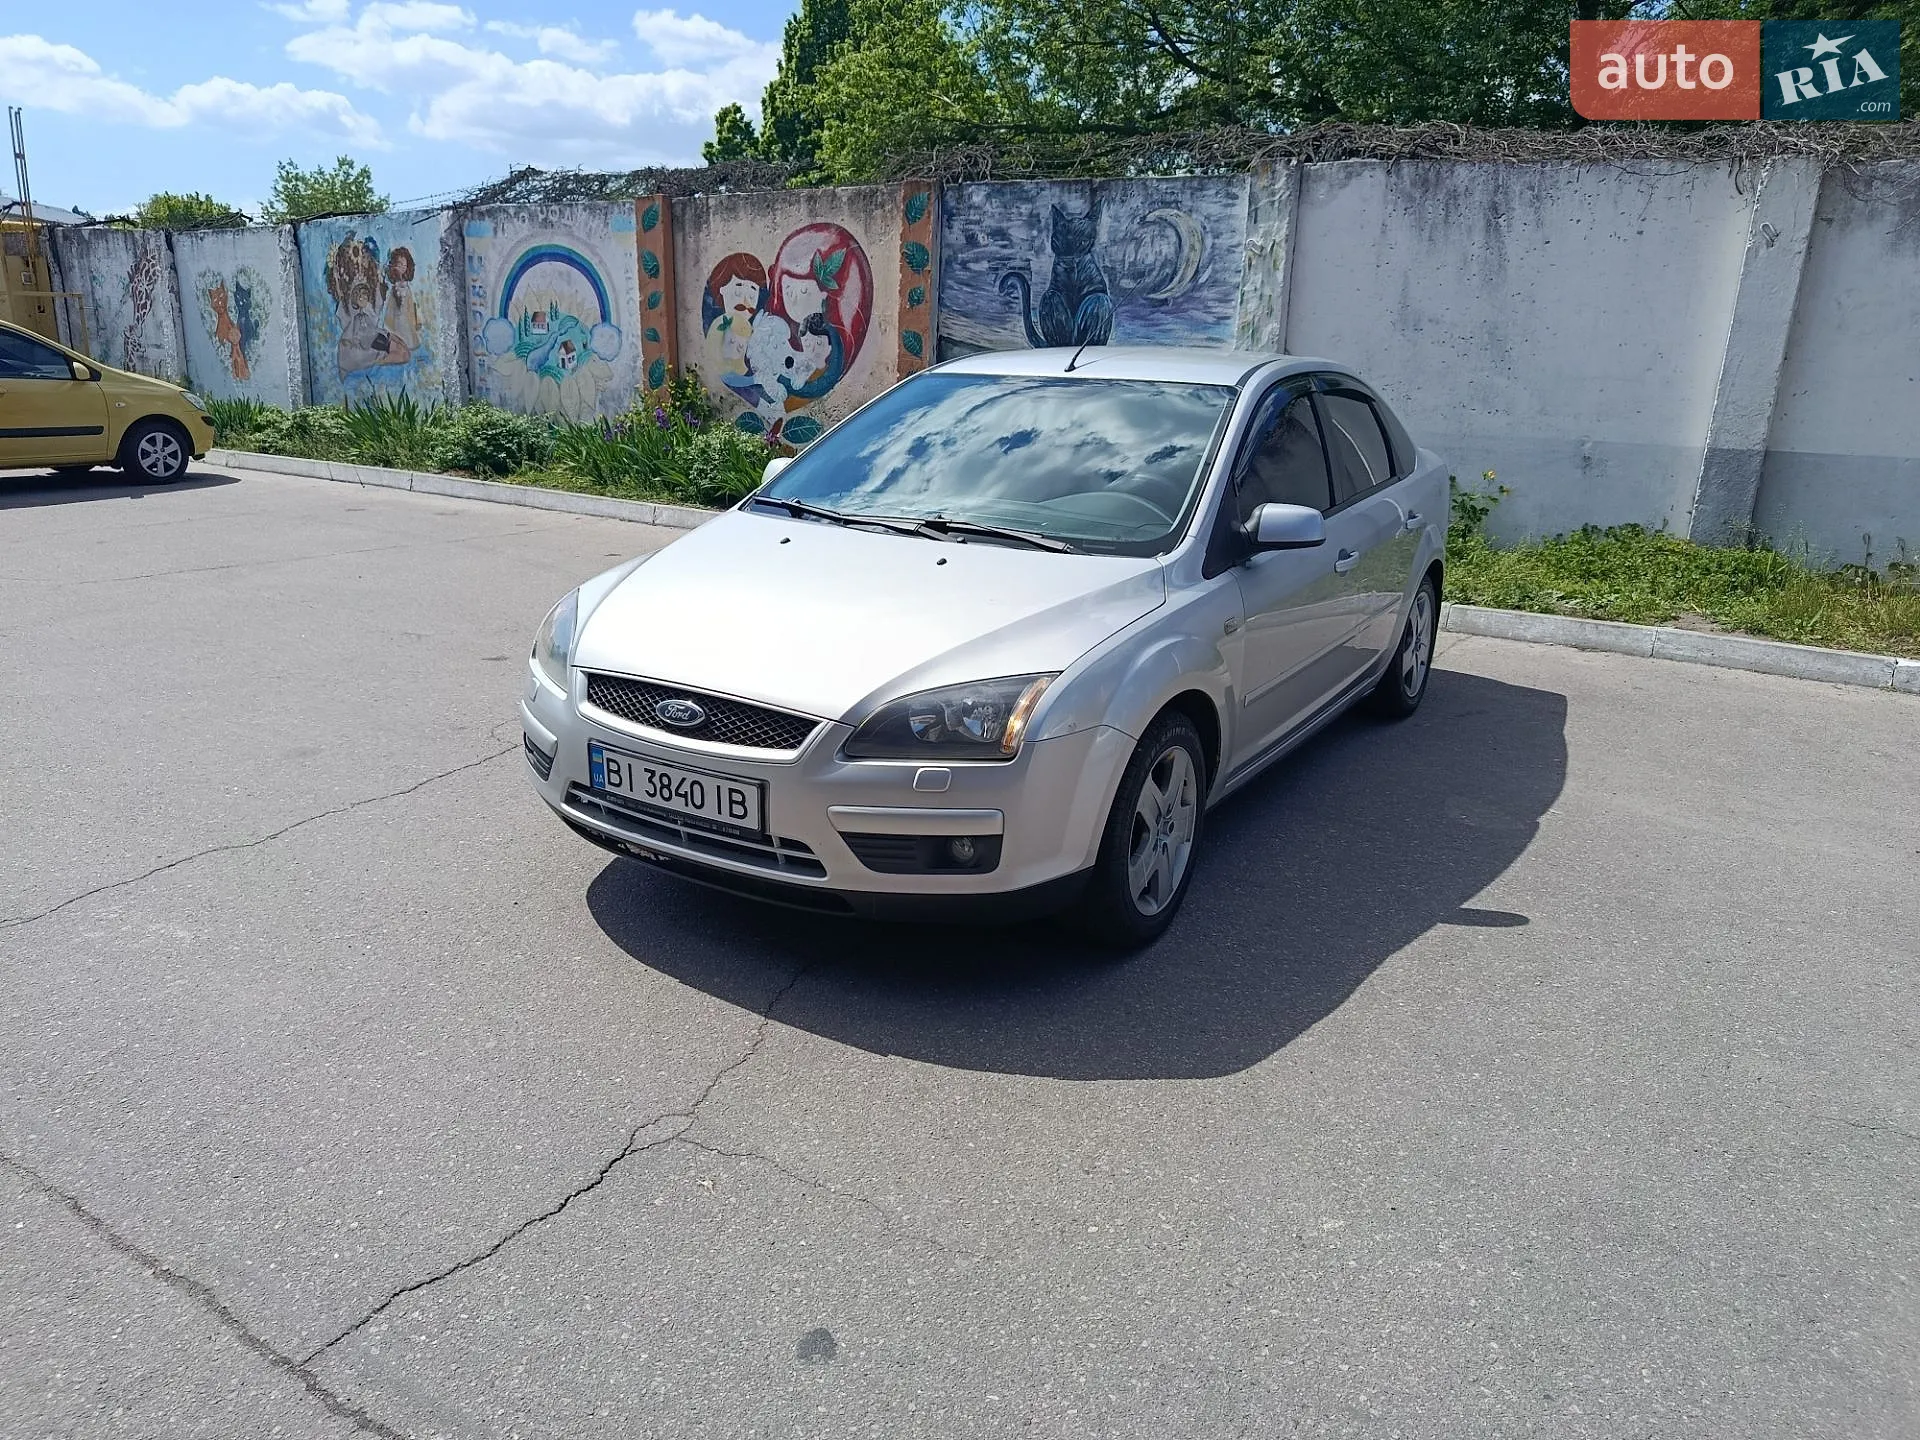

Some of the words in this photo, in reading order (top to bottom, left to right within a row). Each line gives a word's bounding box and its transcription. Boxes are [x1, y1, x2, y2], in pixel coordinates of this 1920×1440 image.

[664, 704, 692, 720] Ford
[593, 772, 604, 784] UA
[606, 757, 633, 792] BI
[643, 767, 705, 810] 3840
[716, 785, 748, 821] IB
